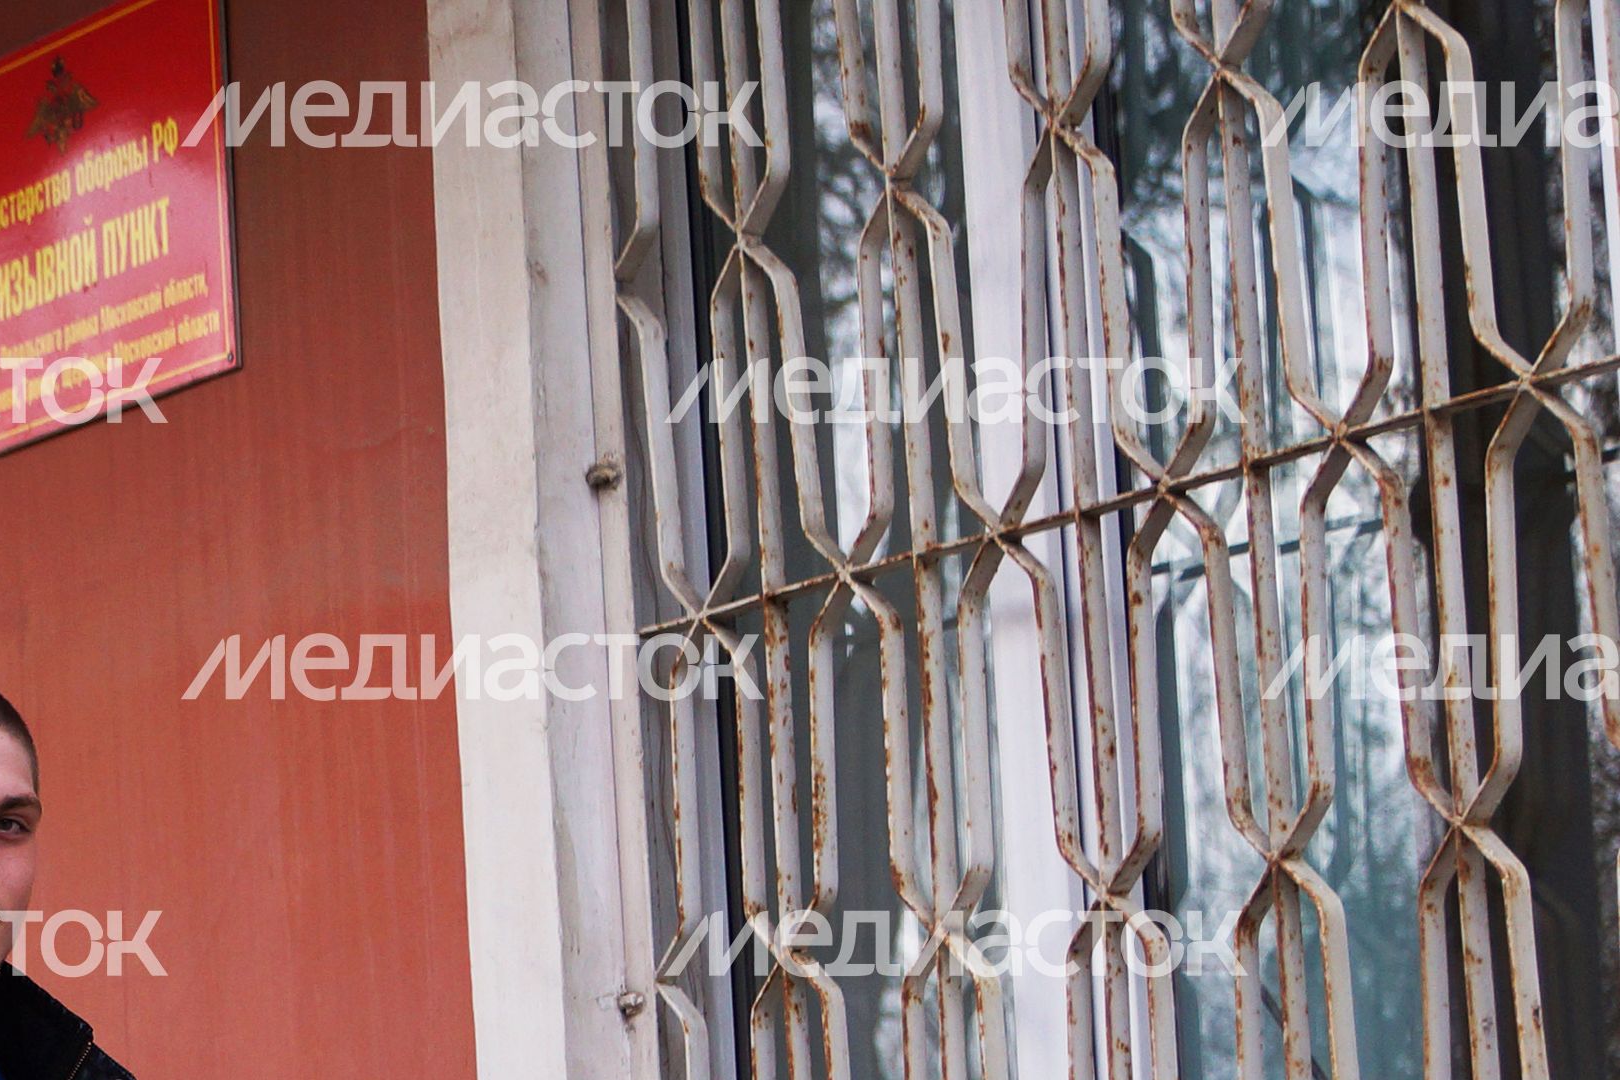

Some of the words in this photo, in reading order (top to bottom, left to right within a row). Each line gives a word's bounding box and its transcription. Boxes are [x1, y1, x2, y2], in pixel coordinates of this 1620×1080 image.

[75, 134, 148, 197] обороны
[152, 117, 178, 163] РФ
[102, 196, 170, 279] ПУНКТ
